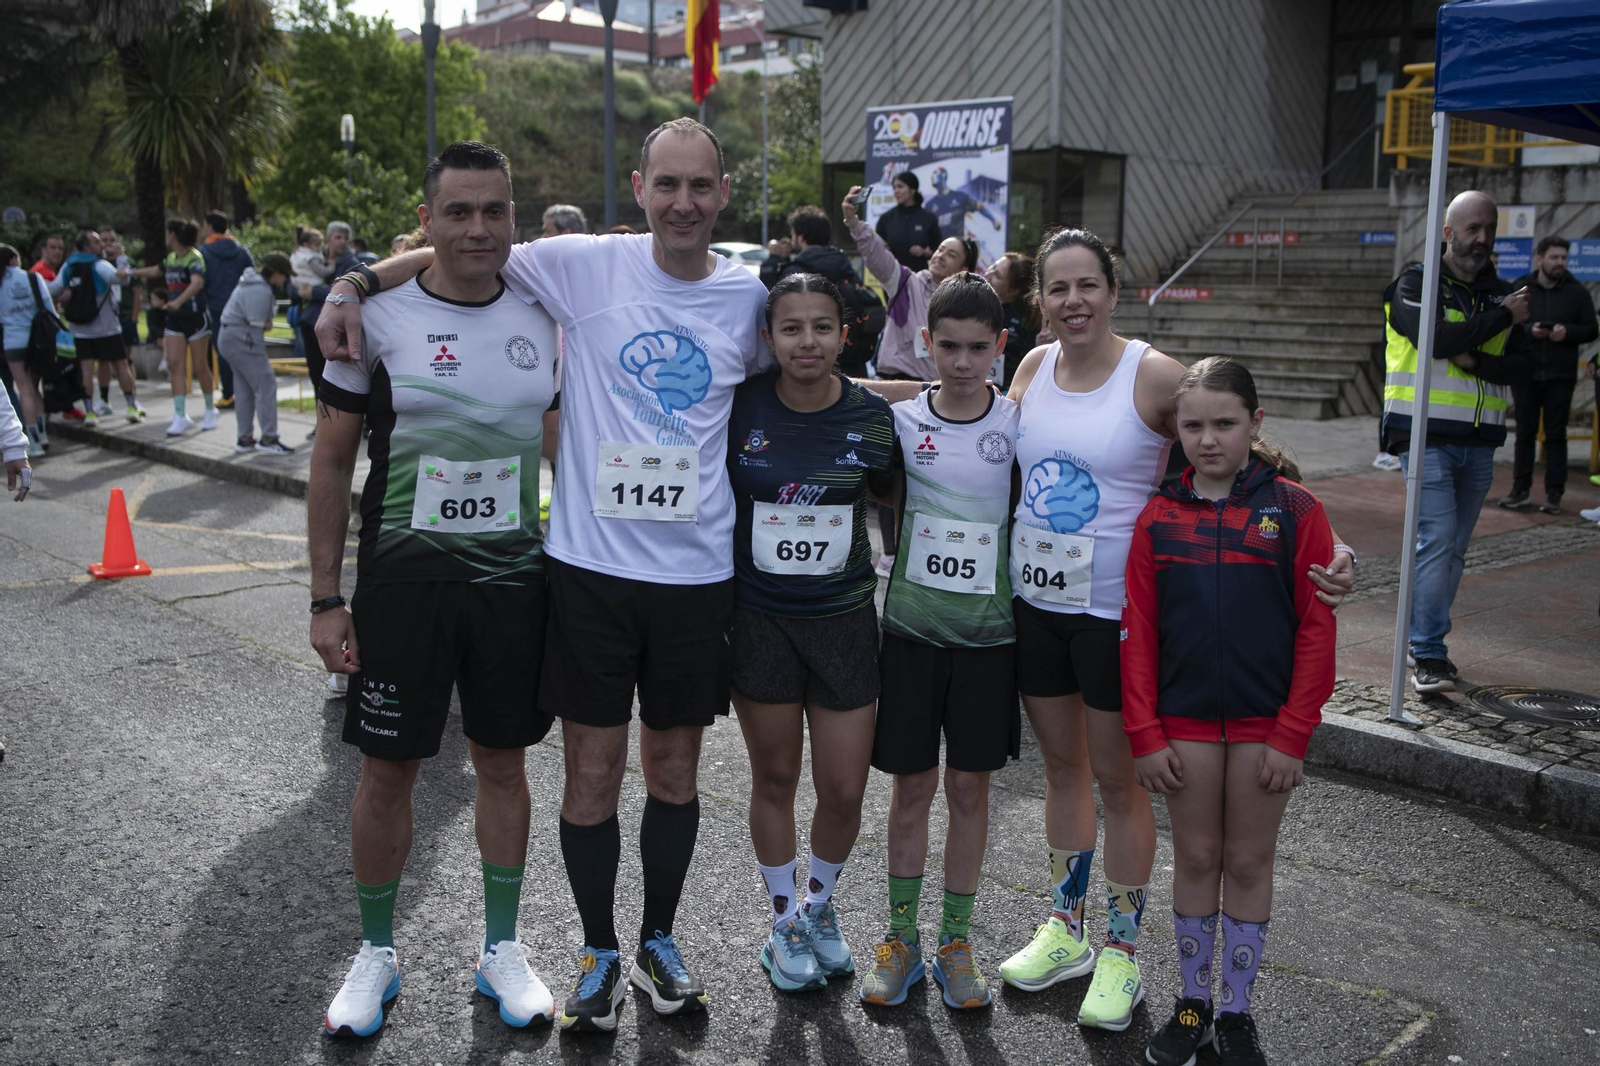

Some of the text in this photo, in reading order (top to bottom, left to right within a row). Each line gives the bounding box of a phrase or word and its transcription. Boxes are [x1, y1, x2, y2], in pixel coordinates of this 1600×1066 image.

[873, 107, 1006, 150] 200 OURENSE
[1165, 287, 1197, 299] PASAR
[672, 324, 710, 352] ATNSASTG
[607, 382, 660, 407] Asociación
[632, 400, 688, 434] Tourette
[641, 456, 661, 465] 200
[835, 457, 869, 468] Santander
[1053, 449, 1093, 471] ATNSASTG
[463, 471, 482, 480] 200
[611, 482, 685, 507] 1147
[440, 496, 496, 520] 603
[946, 530, 965, 539] 200
[776, 540, 829, 562] 697
[926, 553, 976, 579] 605
[1022, 562, 1067, 591] 604
[364, 724, 398, 737] VALCARCE
